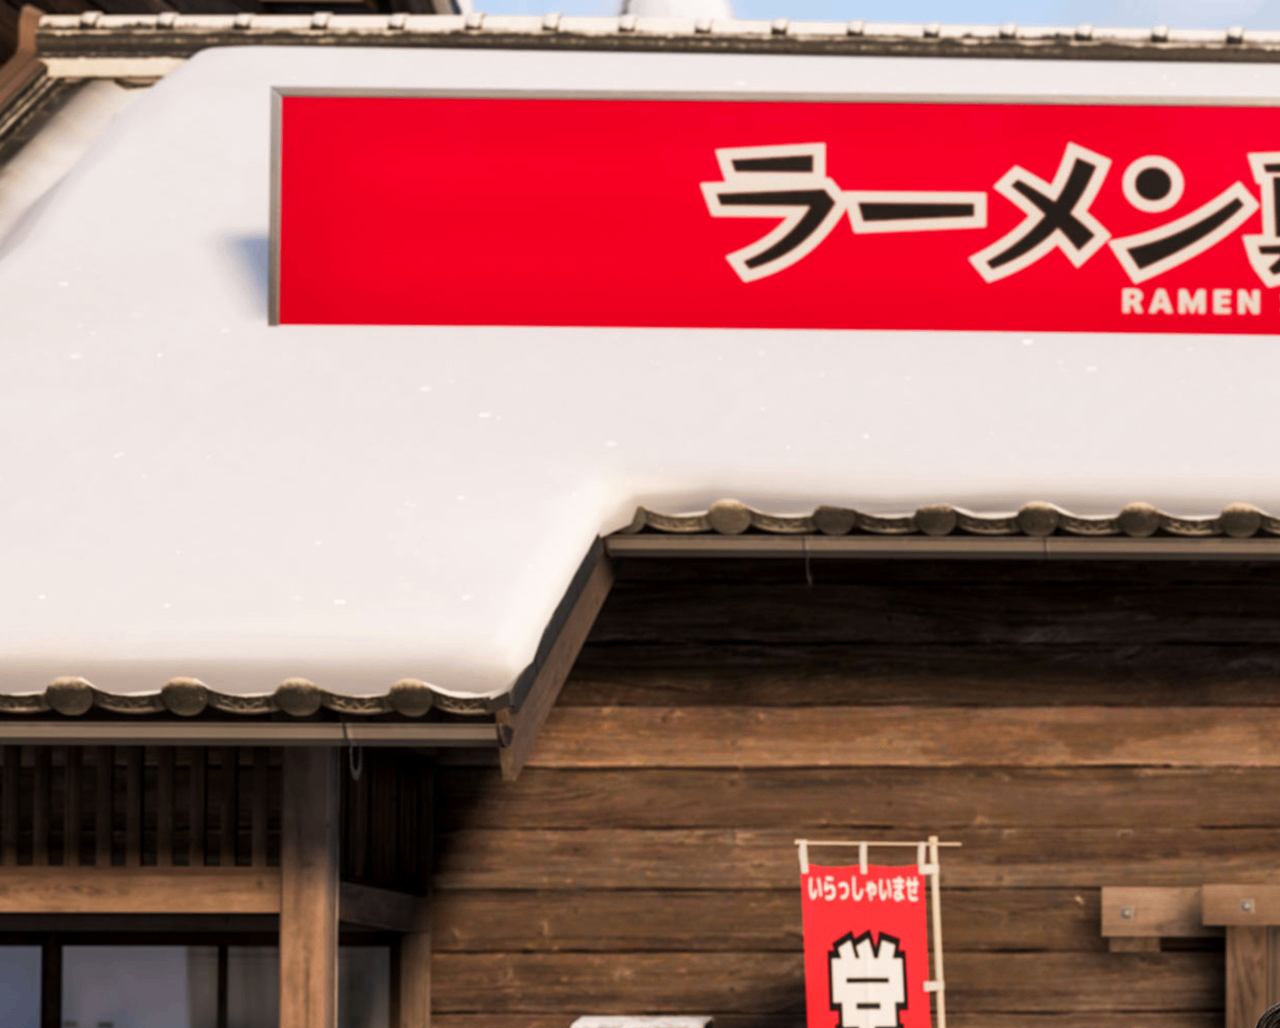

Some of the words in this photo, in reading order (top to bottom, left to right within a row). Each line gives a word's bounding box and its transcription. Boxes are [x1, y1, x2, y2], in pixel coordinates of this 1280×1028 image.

[1120, 287, 1261, 316] RAMEN
[807, 875, 920, 902] いらっしゃいませ
